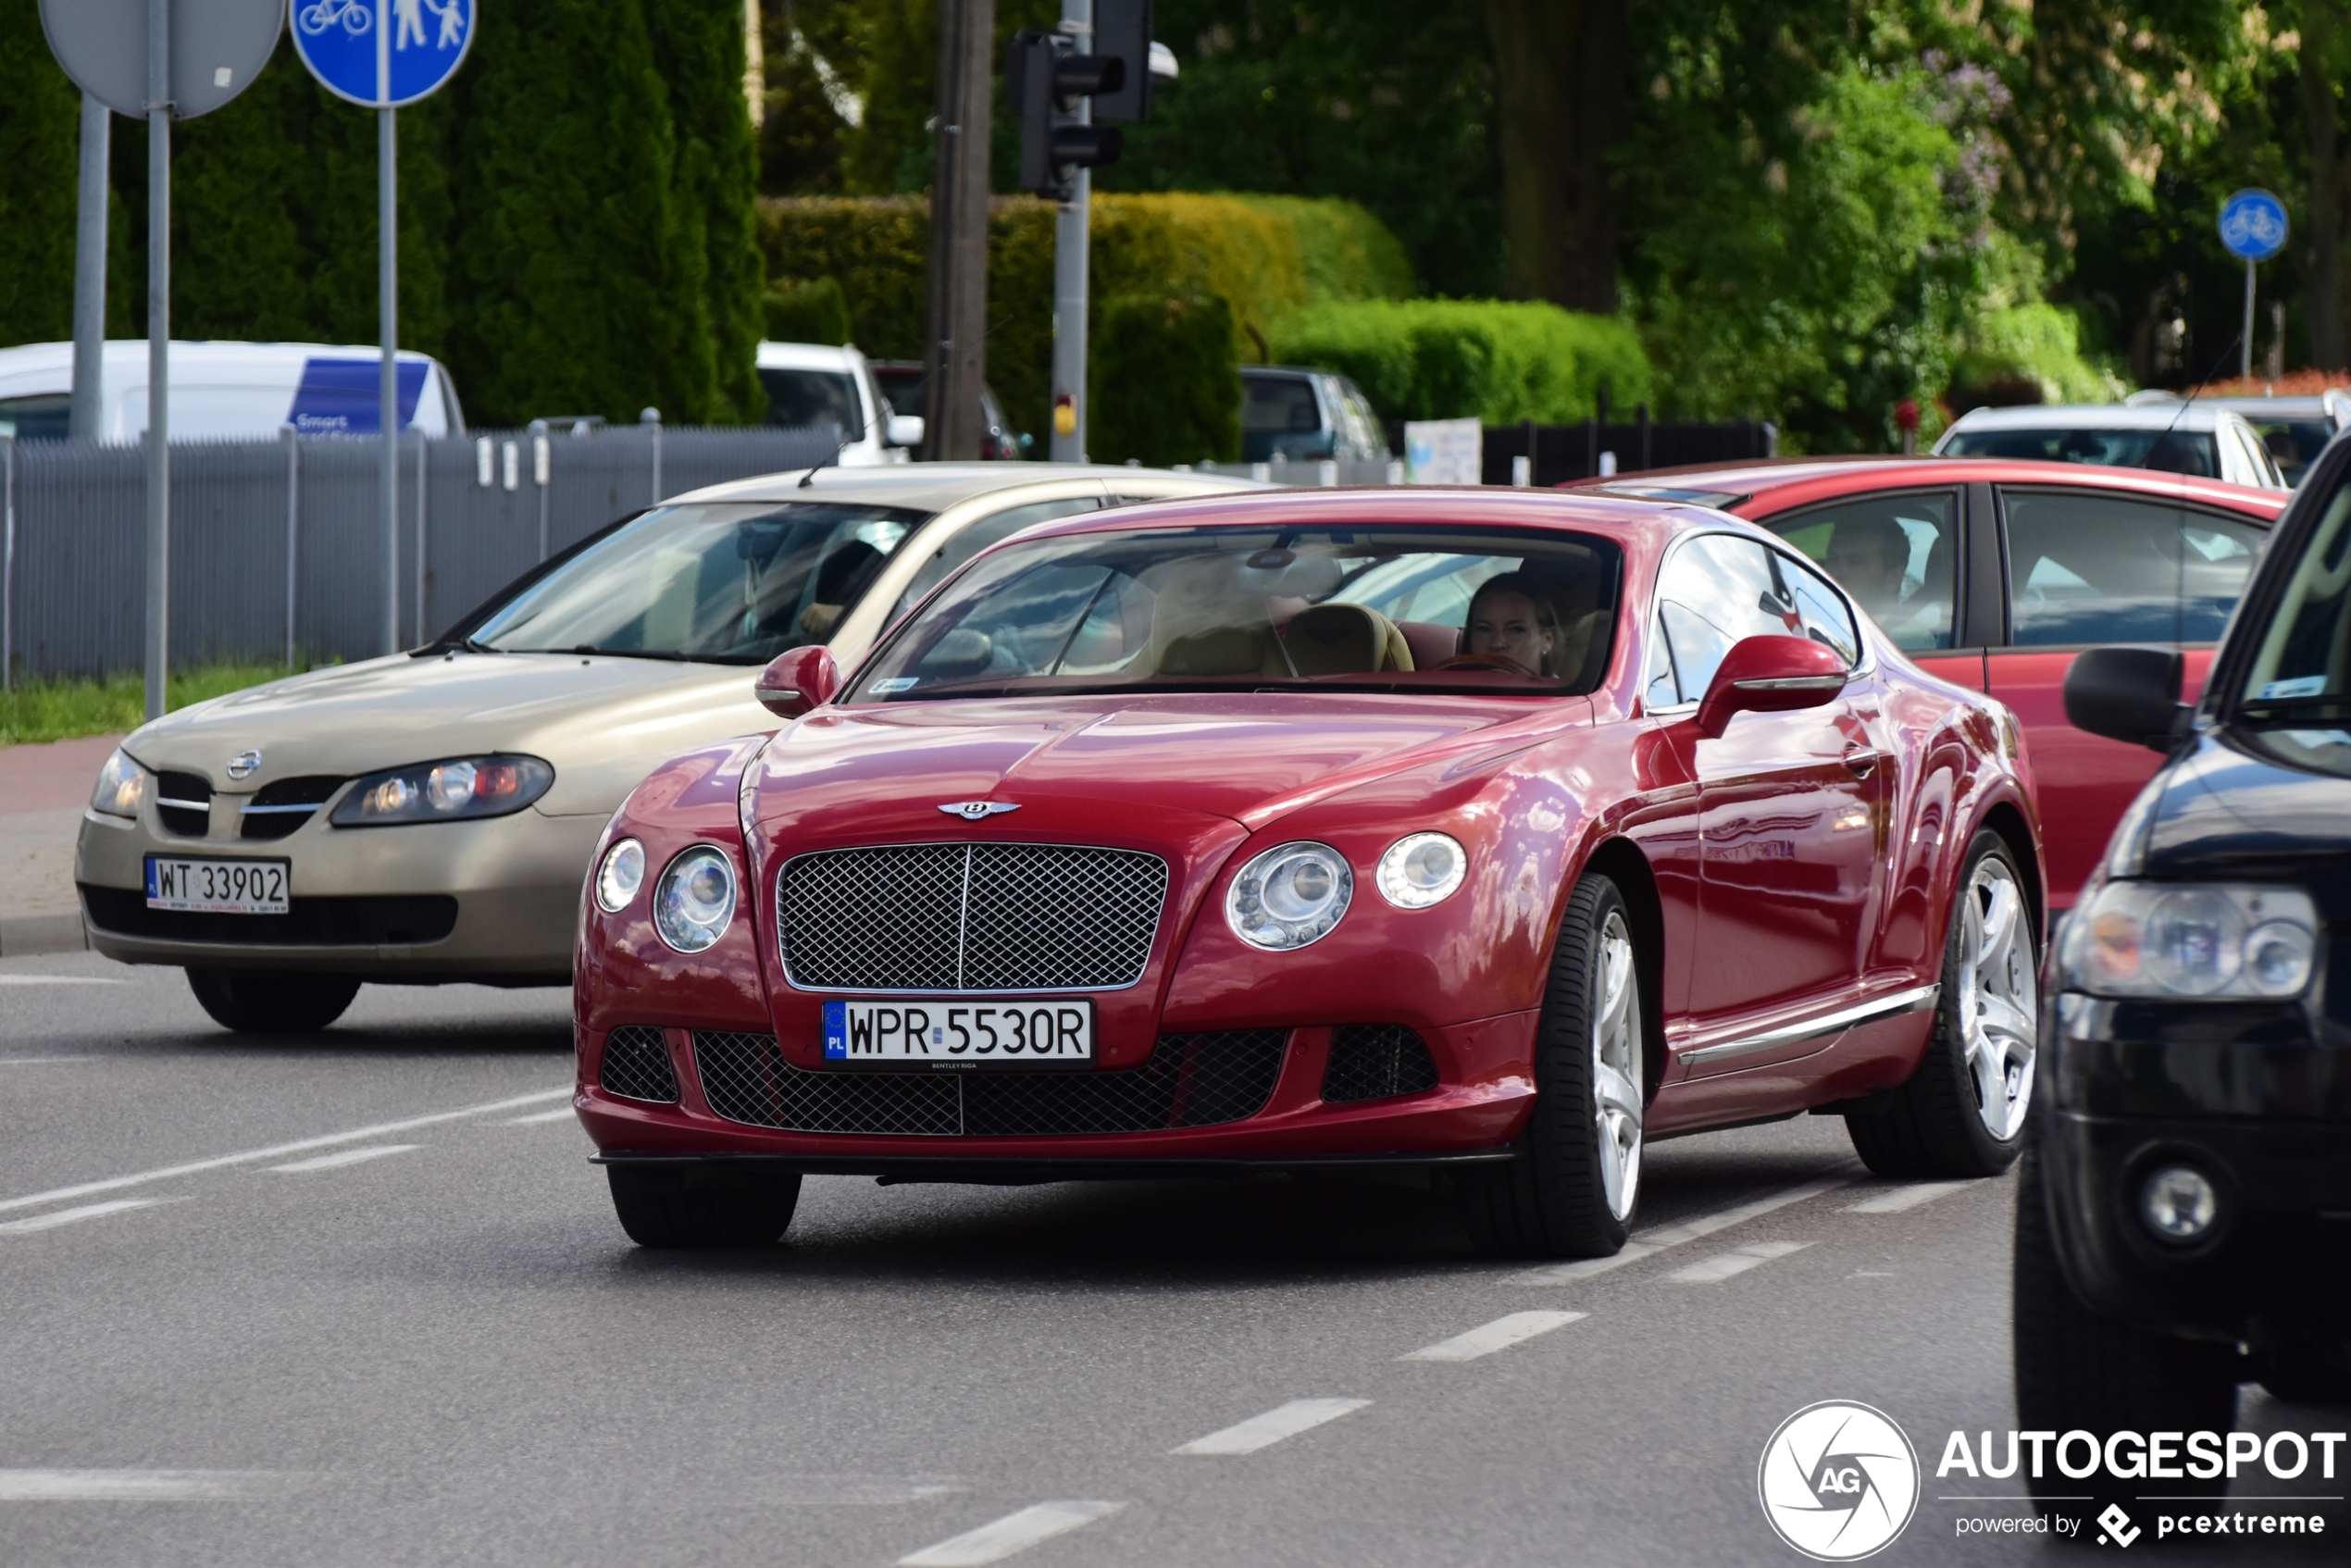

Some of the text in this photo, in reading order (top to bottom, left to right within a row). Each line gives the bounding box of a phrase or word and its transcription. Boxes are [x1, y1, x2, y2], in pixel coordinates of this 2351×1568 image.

[158, 863, 283, 902] WT 33902
[828, 1037, 844, 1051] PL
[849, 1008, 1084, 1054] WPR 5530R
